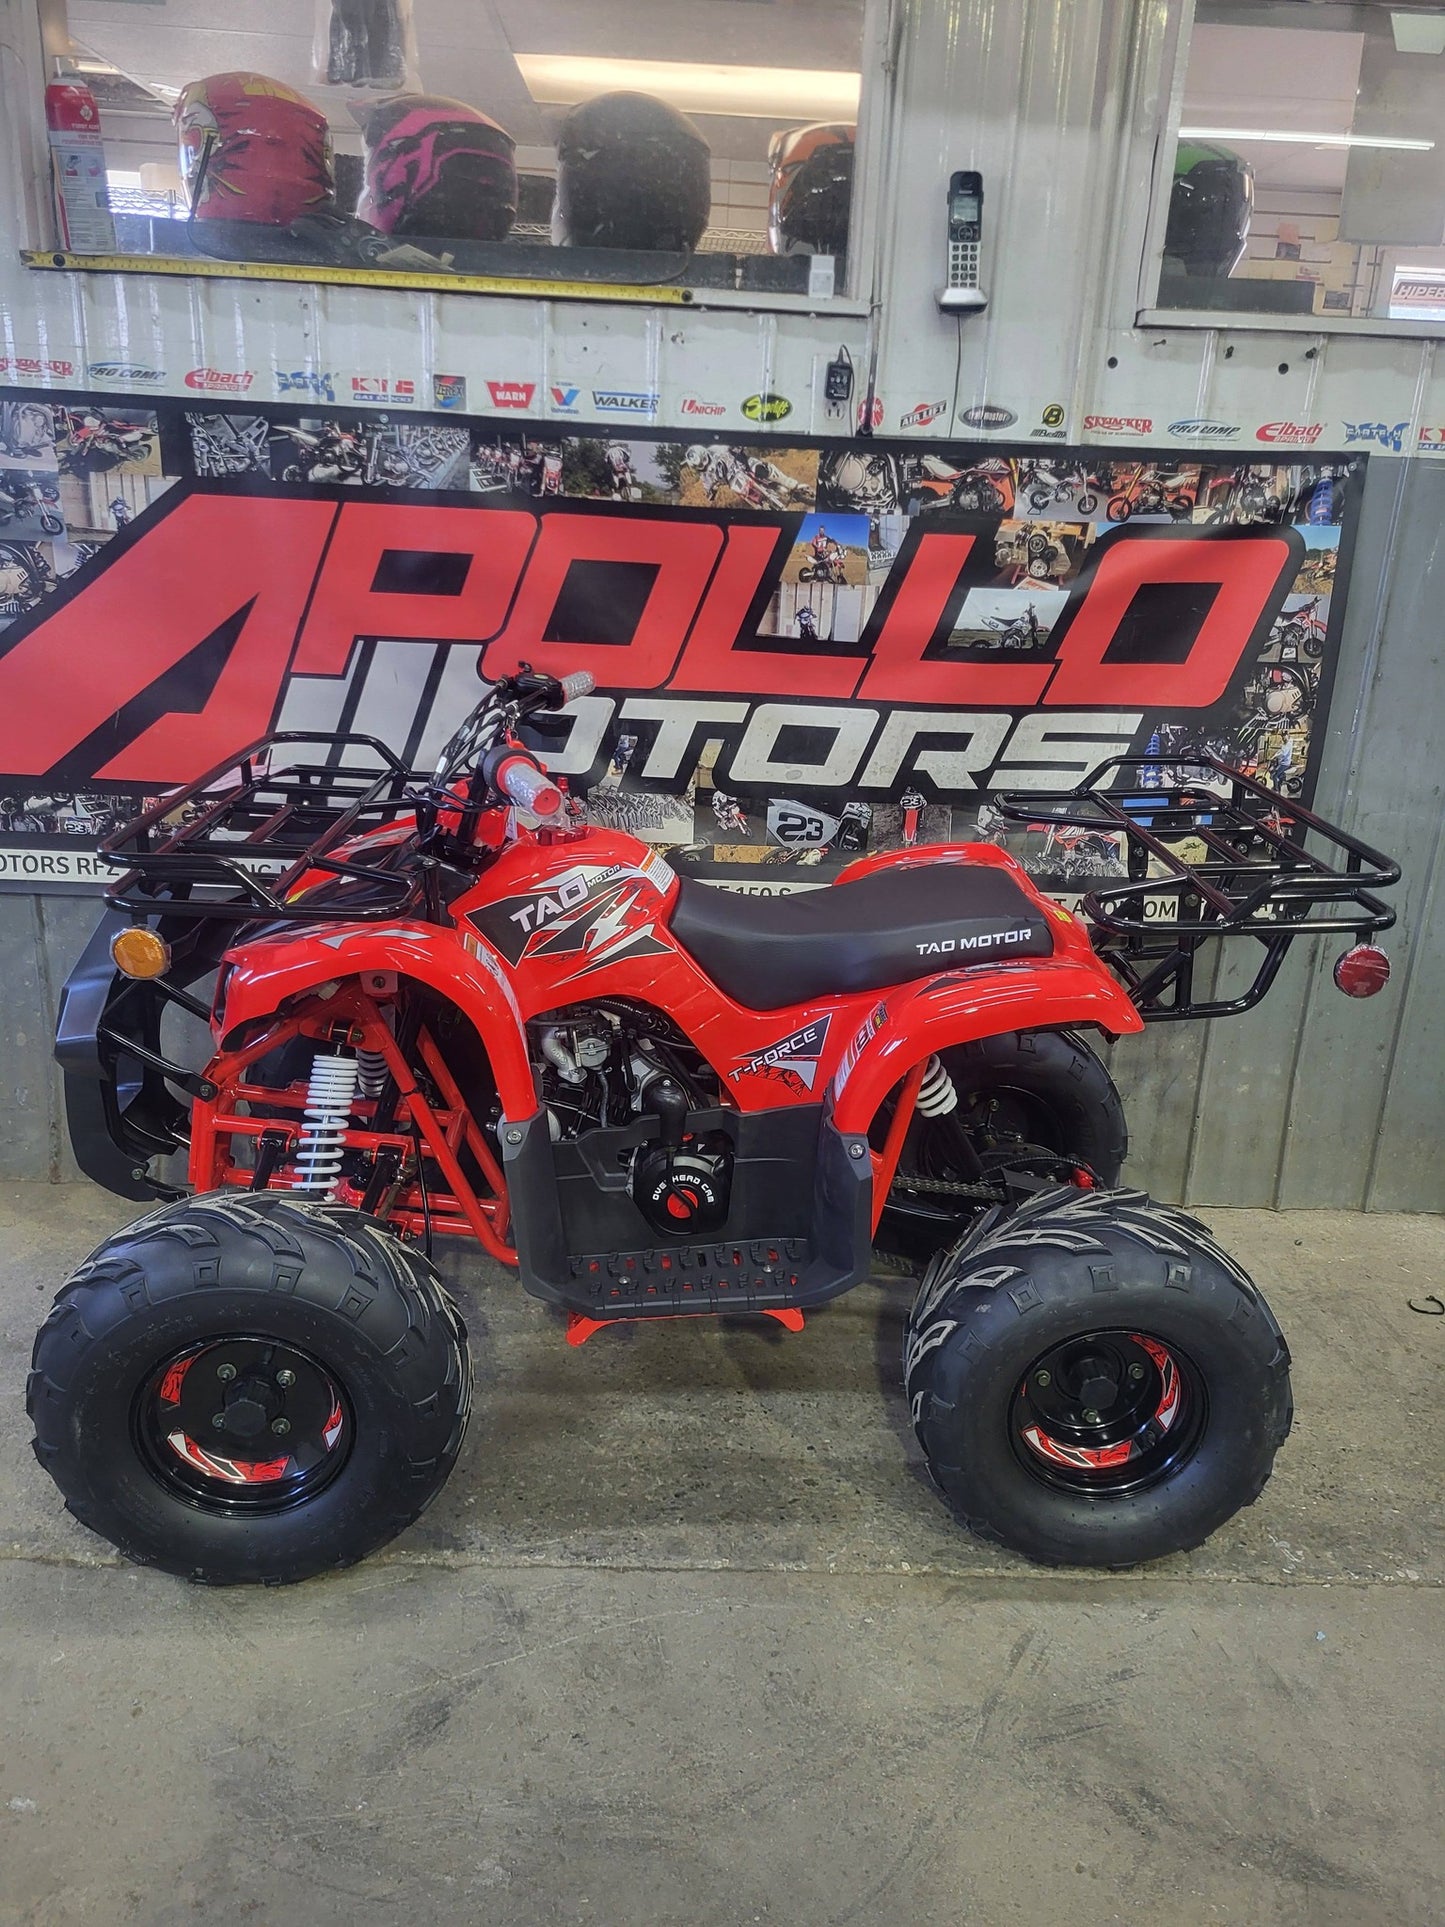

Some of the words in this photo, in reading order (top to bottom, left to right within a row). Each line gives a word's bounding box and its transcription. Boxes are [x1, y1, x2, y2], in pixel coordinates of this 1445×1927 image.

[495, 391, 527, 401] WARN
[592, 390, 659, 413] WALKER
[681, 399, 726, 416] UNICHIP
[901, 414, 922, 428] AIR
[921, 403, 946, 421] LIFT
[1083, 415, 1153, 434] SKYJACKER
[1167, 424, 1200, 433] PRO
[1199, 425, 1241, 438] COMP
[0, 493, 1291, 784] APOLLO
[253, 638, 1145, 820] MOTORS
[776, 812, 824, 843] 23
[509, 873, 589, 933] TAO
[586, 864, 622, 889] MOTOR
[916, 939, 956, 956] TAO
[960, 928, 1032, 950] MOTOR
[728, 1027, 819, 1083] T-FORCE
